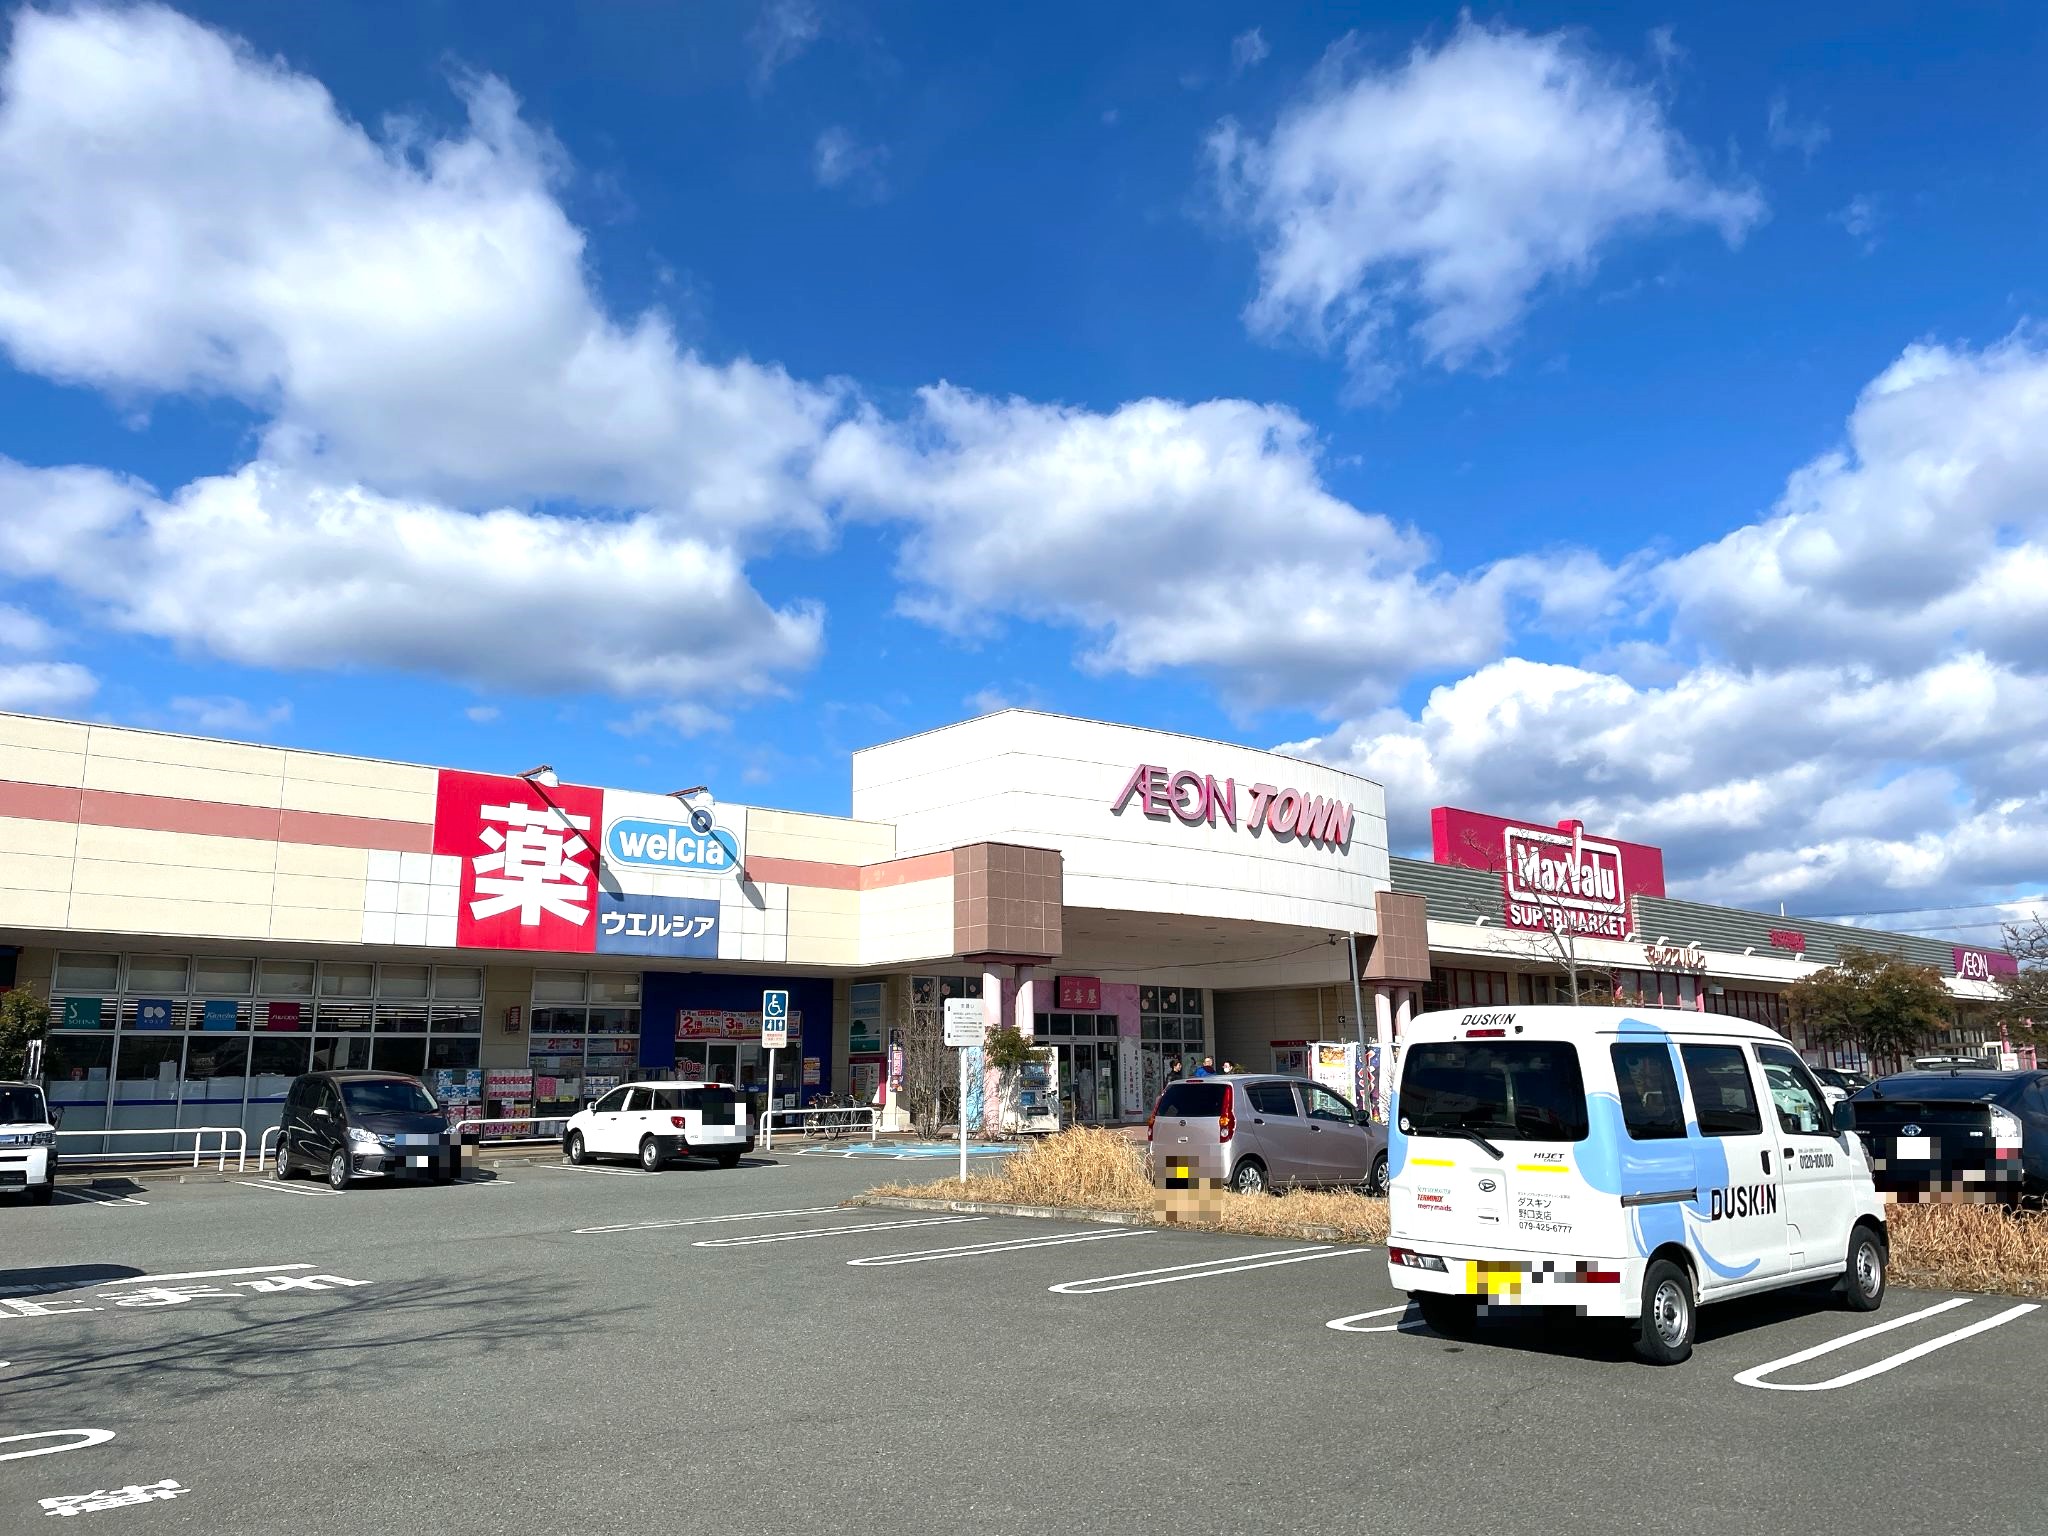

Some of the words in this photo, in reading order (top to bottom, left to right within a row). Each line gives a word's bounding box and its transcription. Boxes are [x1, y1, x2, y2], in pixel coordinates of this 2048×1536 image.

[1247, 783, 1353, 845] TOWN
[618, 828, 726, 866] welcia
[469, 802, 591, 926] 薬
[1516, 827, 1616, 899] MaxValu
[601, 911, 715, 938] ウエルシア
[1511, 905, 1626, 936] SUPERMARKET
[1518, 1198, 1551, 1208] ダスキン
[1519, 1209, 1552, 1221] 野口支店
[1519, 1221, 1572, 1233] 079-425-6777
